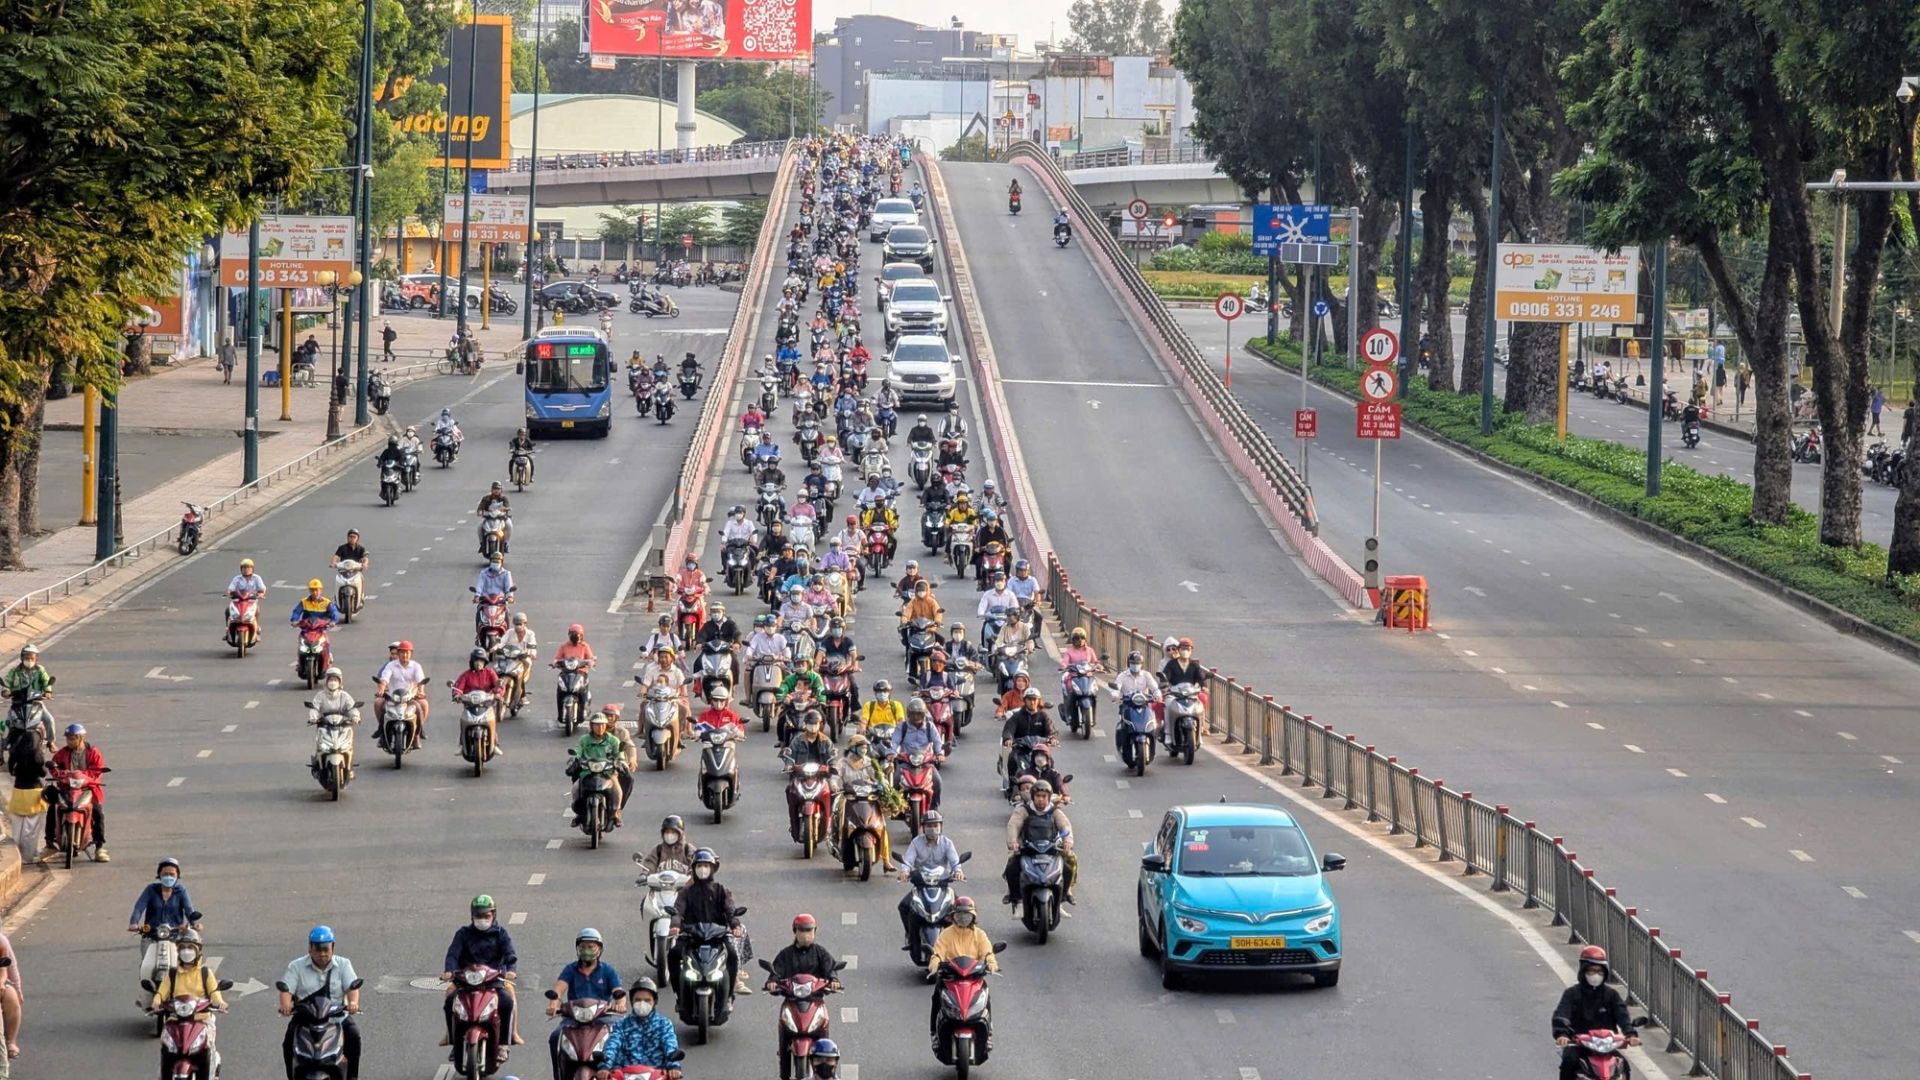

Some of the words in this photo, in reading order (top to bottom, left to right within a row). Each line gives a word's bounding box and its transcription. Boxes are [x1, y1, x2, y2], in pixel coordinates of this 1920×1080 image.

[1133, 204, 1144, 214] 30
[481, 231, 498, 239] 331
[502, 231, 521, 239] 246
[235, 269, 275, 281] 008
[280, 270, 308, 282] 343
[1222, 299, 1235, 312] 40
[1510, 303, 1549, 316] 0906
[1555, 303, 1583, 317] 331
[1590, 304, 1620, 318] 246
[1367, 402, 1391, 413] CẤM
